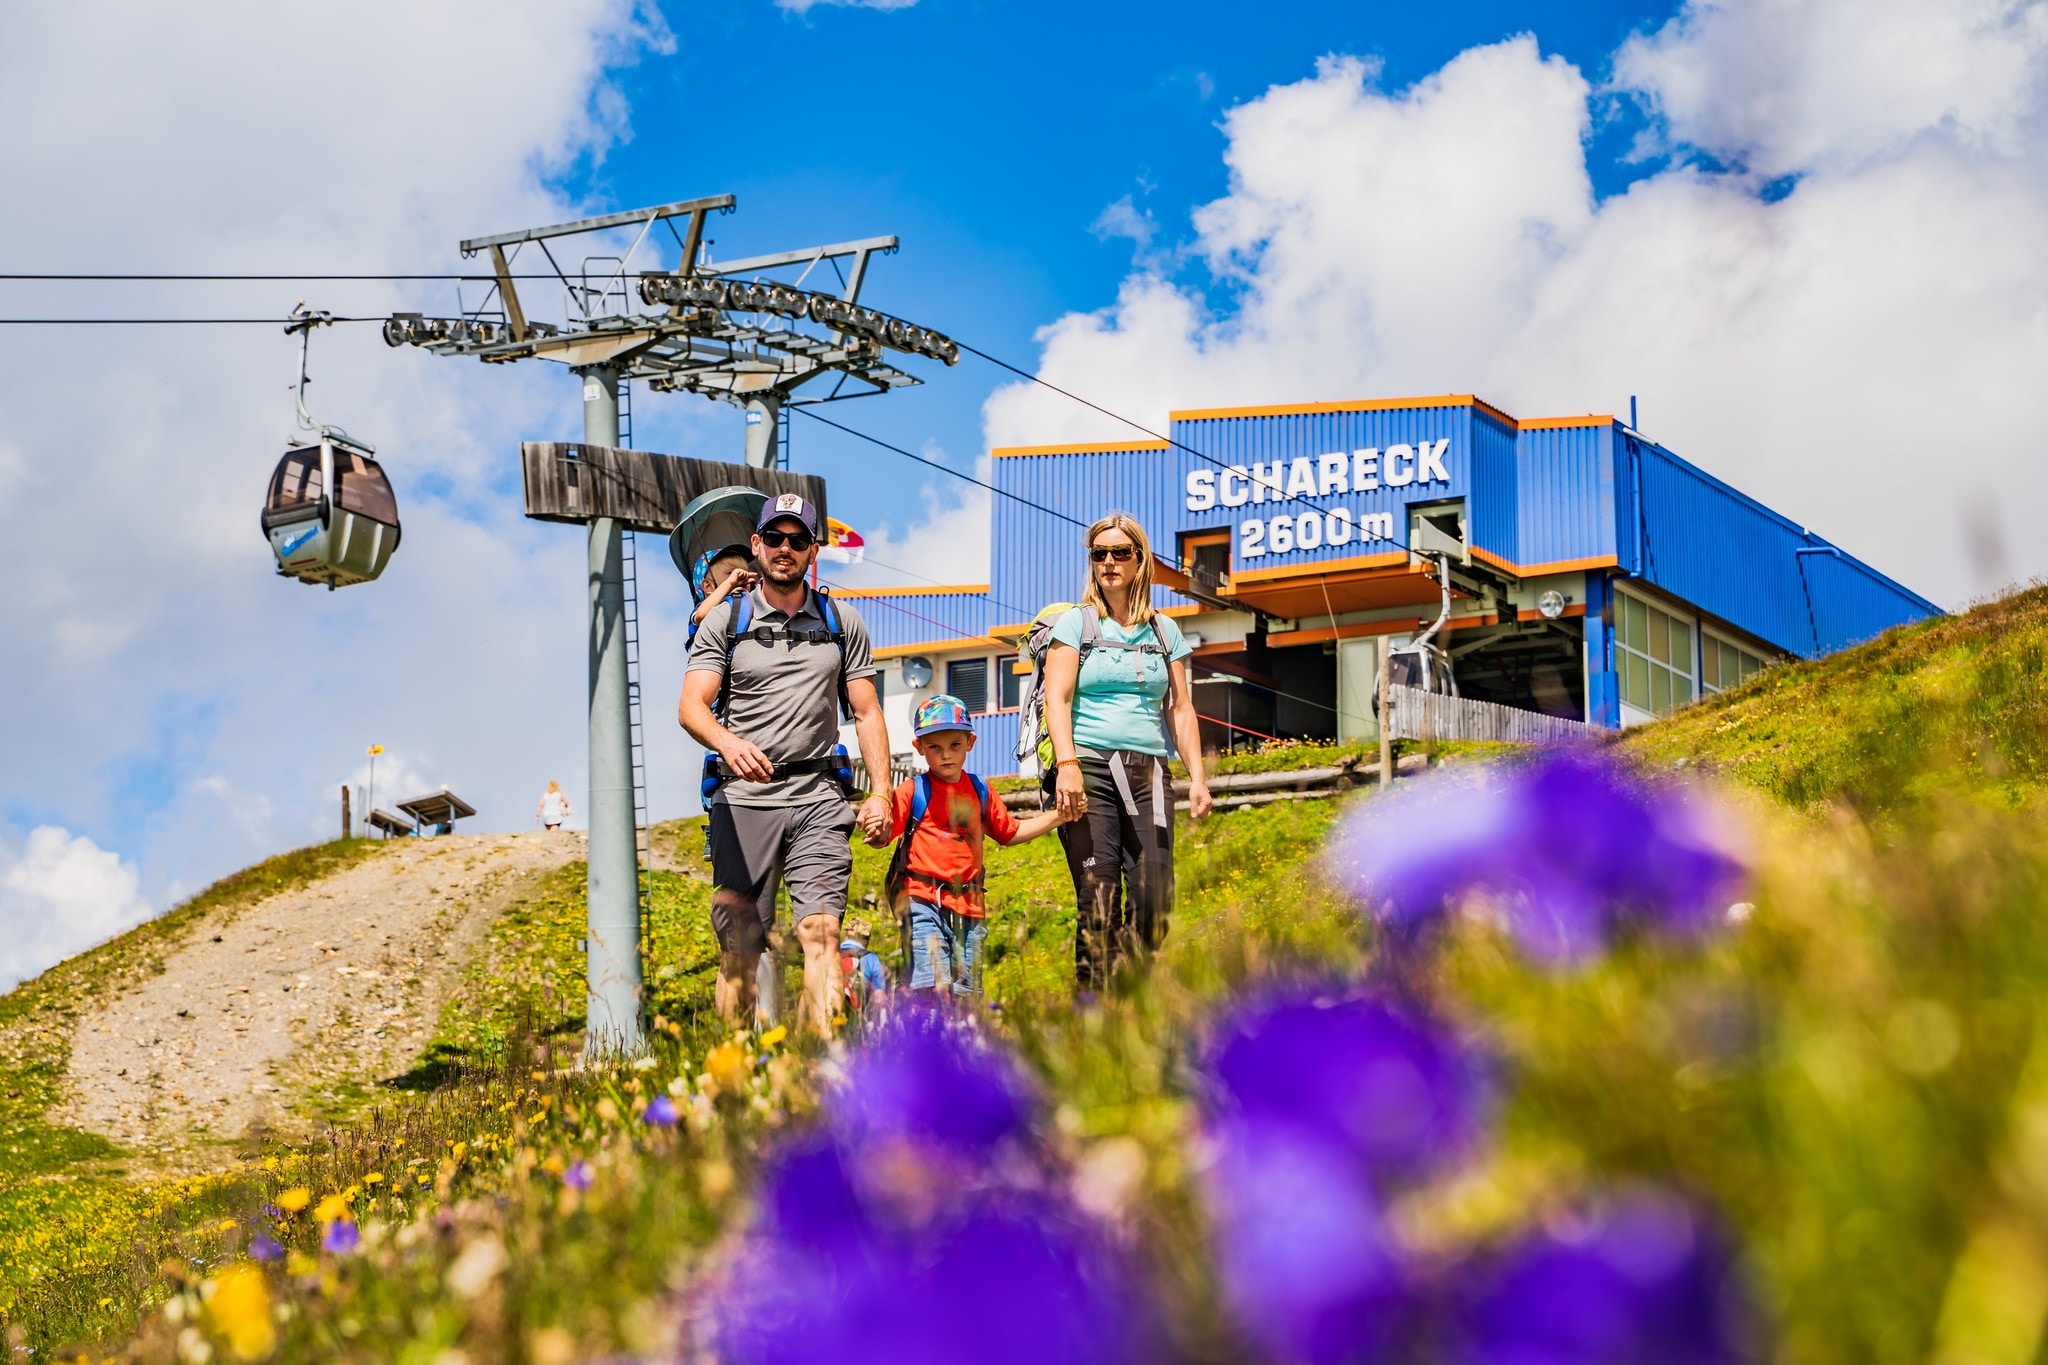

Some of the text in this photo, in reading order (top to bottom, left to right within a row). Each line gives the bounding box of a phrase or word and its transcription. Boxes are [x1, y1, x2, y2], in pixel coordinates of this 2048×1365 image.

[1186, 438, 1451, 512] SCHARECK
[1239, 507, 1394, 559] 2600 m
